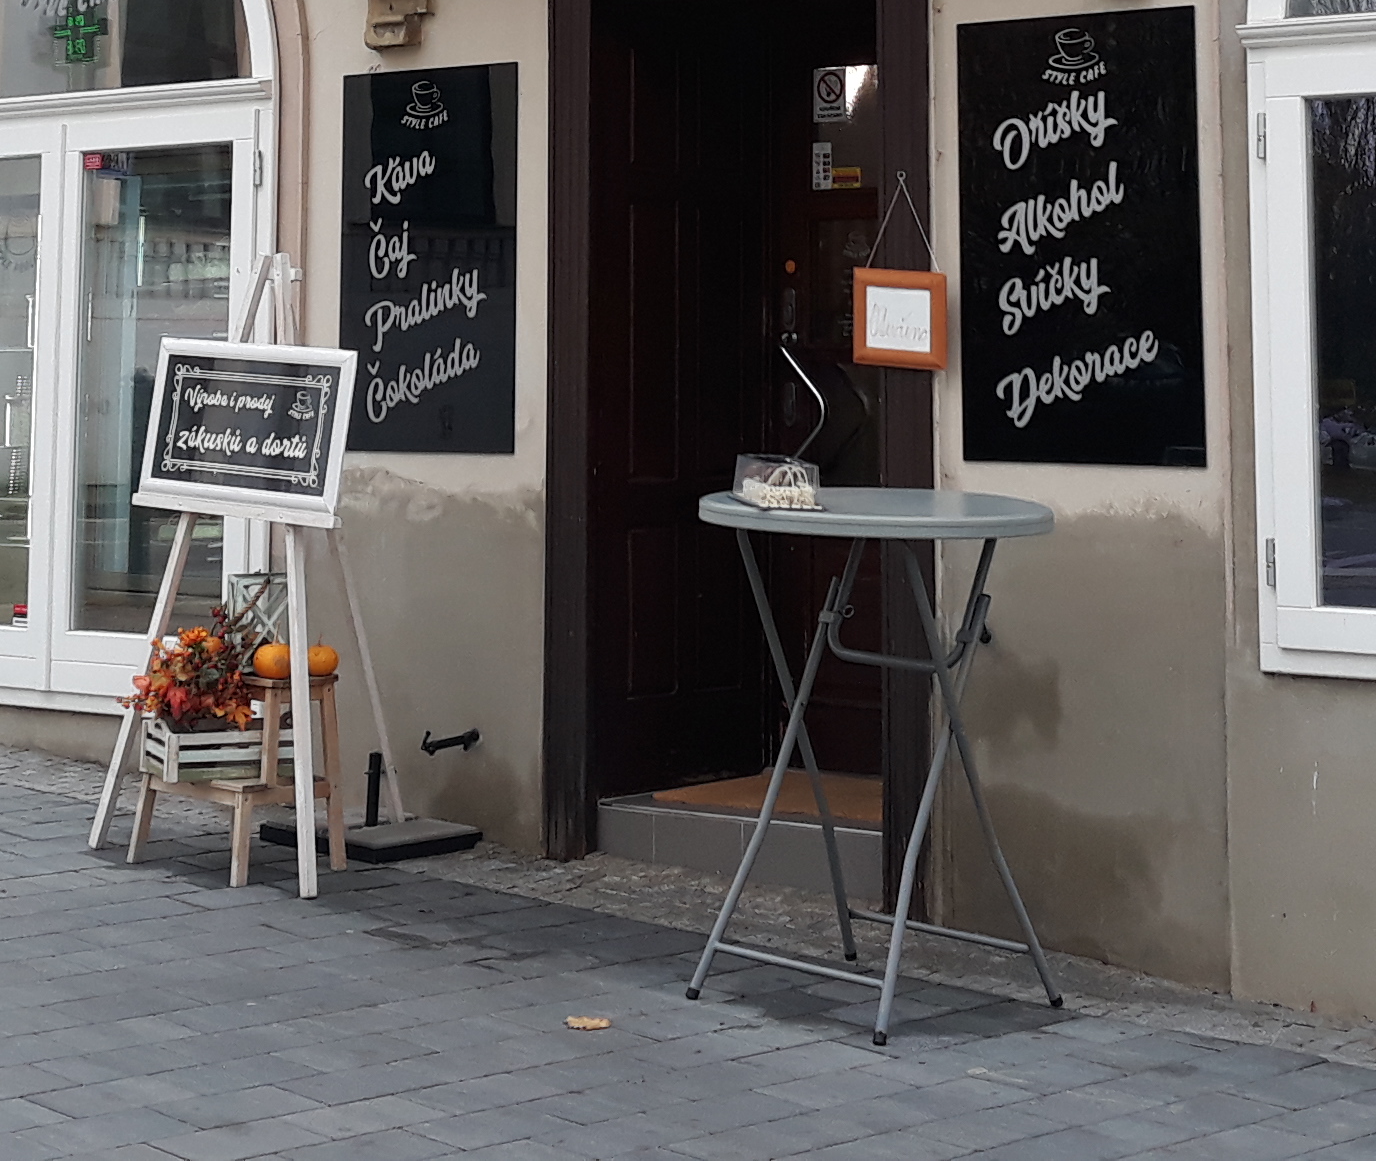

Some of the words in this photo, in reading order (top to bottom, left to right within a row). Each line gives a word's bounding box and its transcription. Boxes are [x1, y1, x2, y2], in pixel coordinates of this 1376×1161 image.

[1041, 69, 1076, 85] STYLE
[1079, 60, 1107, 84] CAFE
[400, 115, 426, 130] STYLE
[428, 109, 449, 129] CAFE
[992, 90, 1118, 170] Oříšky
[364, 150, 436, 205] Káva
[997, 160, 1125, 256] Alkohol
[368, 217, 417, 280] Čaj
[364, 267, 488, 352] Pralinky
[998, 256, 1112, 336] Svíčky
[184, 383, 228, 413] Výroba
[229, 391, 235, 408] i
[235, 391, 276, 419] prodej
[366, 338, 481, 424] Čokoláda
[996, 329, 1159, 428] Dekorace
[245, 441, 259, 455] a
[261, 432, 308, 460] dortů
